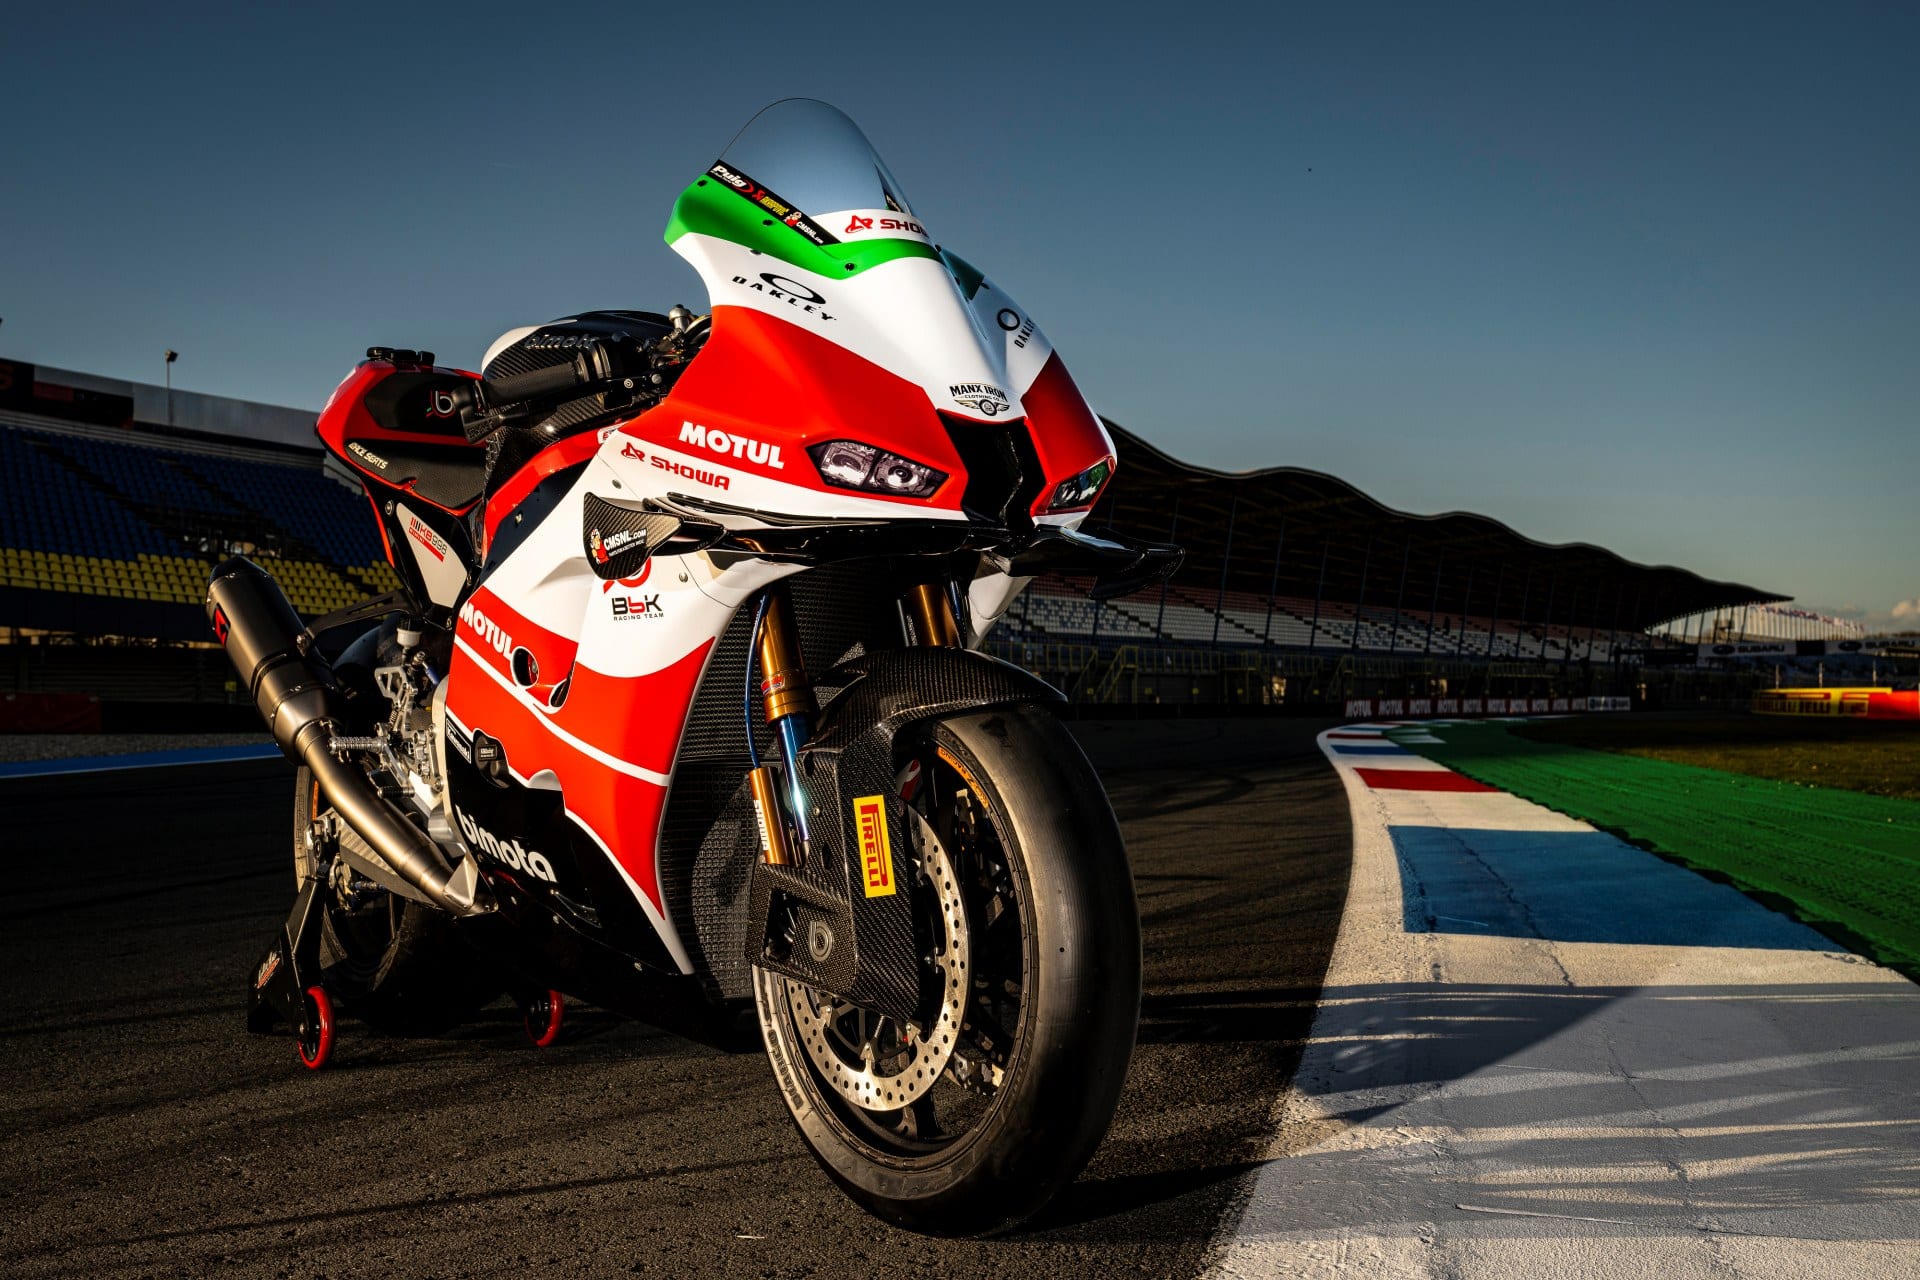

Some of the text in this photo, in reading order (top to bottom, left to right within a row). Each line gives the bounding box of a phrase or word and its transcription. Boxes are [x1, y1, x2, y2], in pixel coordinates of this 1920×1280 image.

[712, 165, 747, 188] Puig
[732, 276, 834, 321] OAKLEY
[1014, 317, 1036, 348] OAKLE
[949, 384, 1009, 402] MANX IRON
[364, 452, 389, 470] SEATS
[678, 421, 785, 470] MOTUL
[650, 455, 730, 491] SHOWA
[458, 601, 513, 658] MOTUL
[1737, 645, 1785, 653] SUBARU
[1345, 700, 1372, 718] MOTUL
[1378, 700, 1403, 715] MOTUL
[455, 804, 558, 884] bimota
[860, 803, 888, 887] PIRELLI
